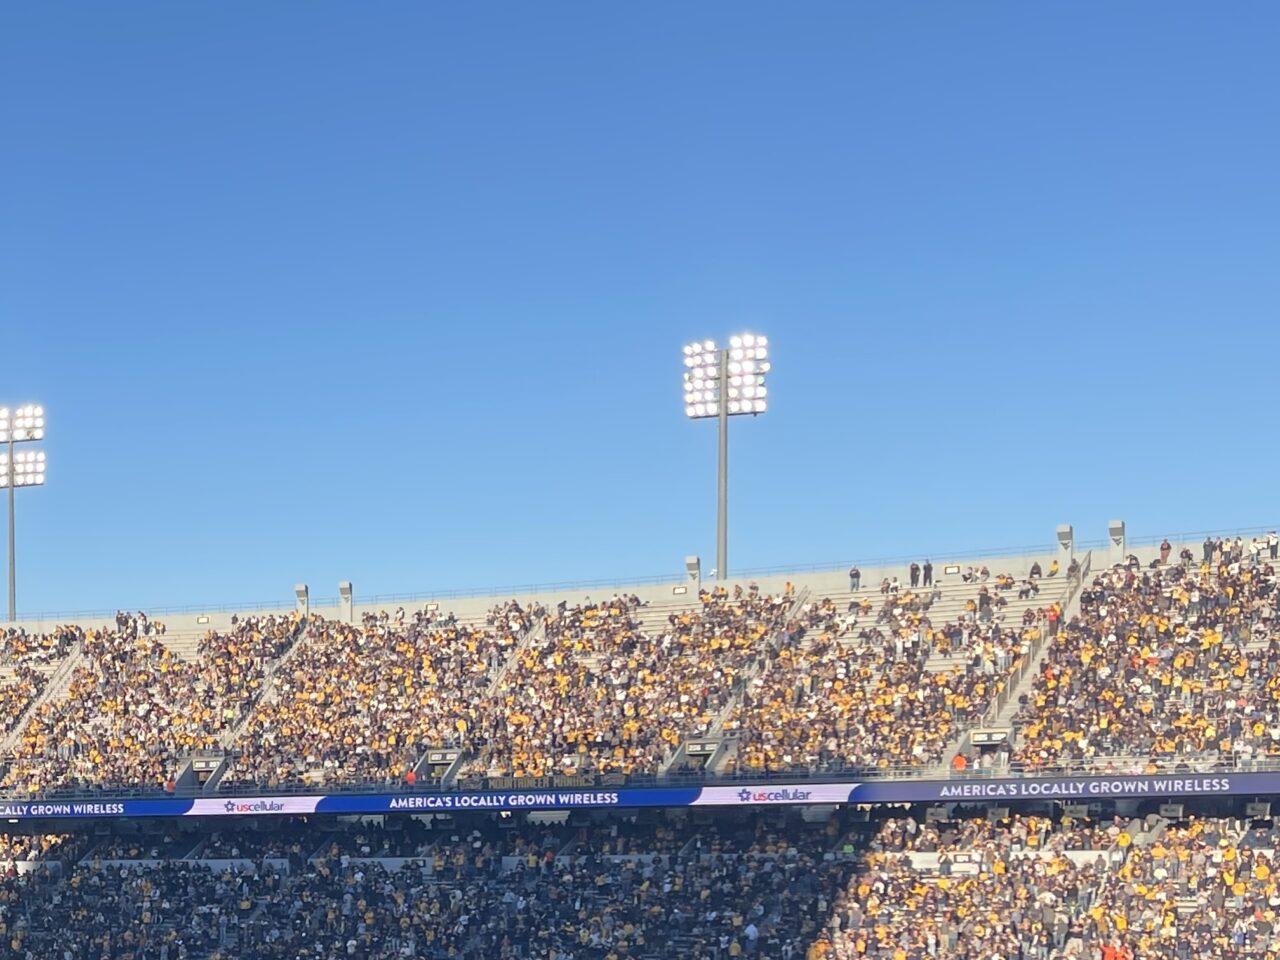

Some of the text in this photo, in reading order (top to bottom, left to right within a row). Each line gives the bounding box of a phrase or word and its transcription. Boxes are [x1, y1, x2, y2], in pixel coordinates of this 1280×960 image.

[488, 777, 549, 788] MOUNTAINEER
[940, 779, 1231, 796] AMERICA'S LOCALLY GROWN WIRELESS
[389, 792, 619, 808] AMERICA'S LOCALLY GROWN WIRELESS
[30, 804, 70, 815] GROWN
[73, 802, 124, 815] WIRELESS
